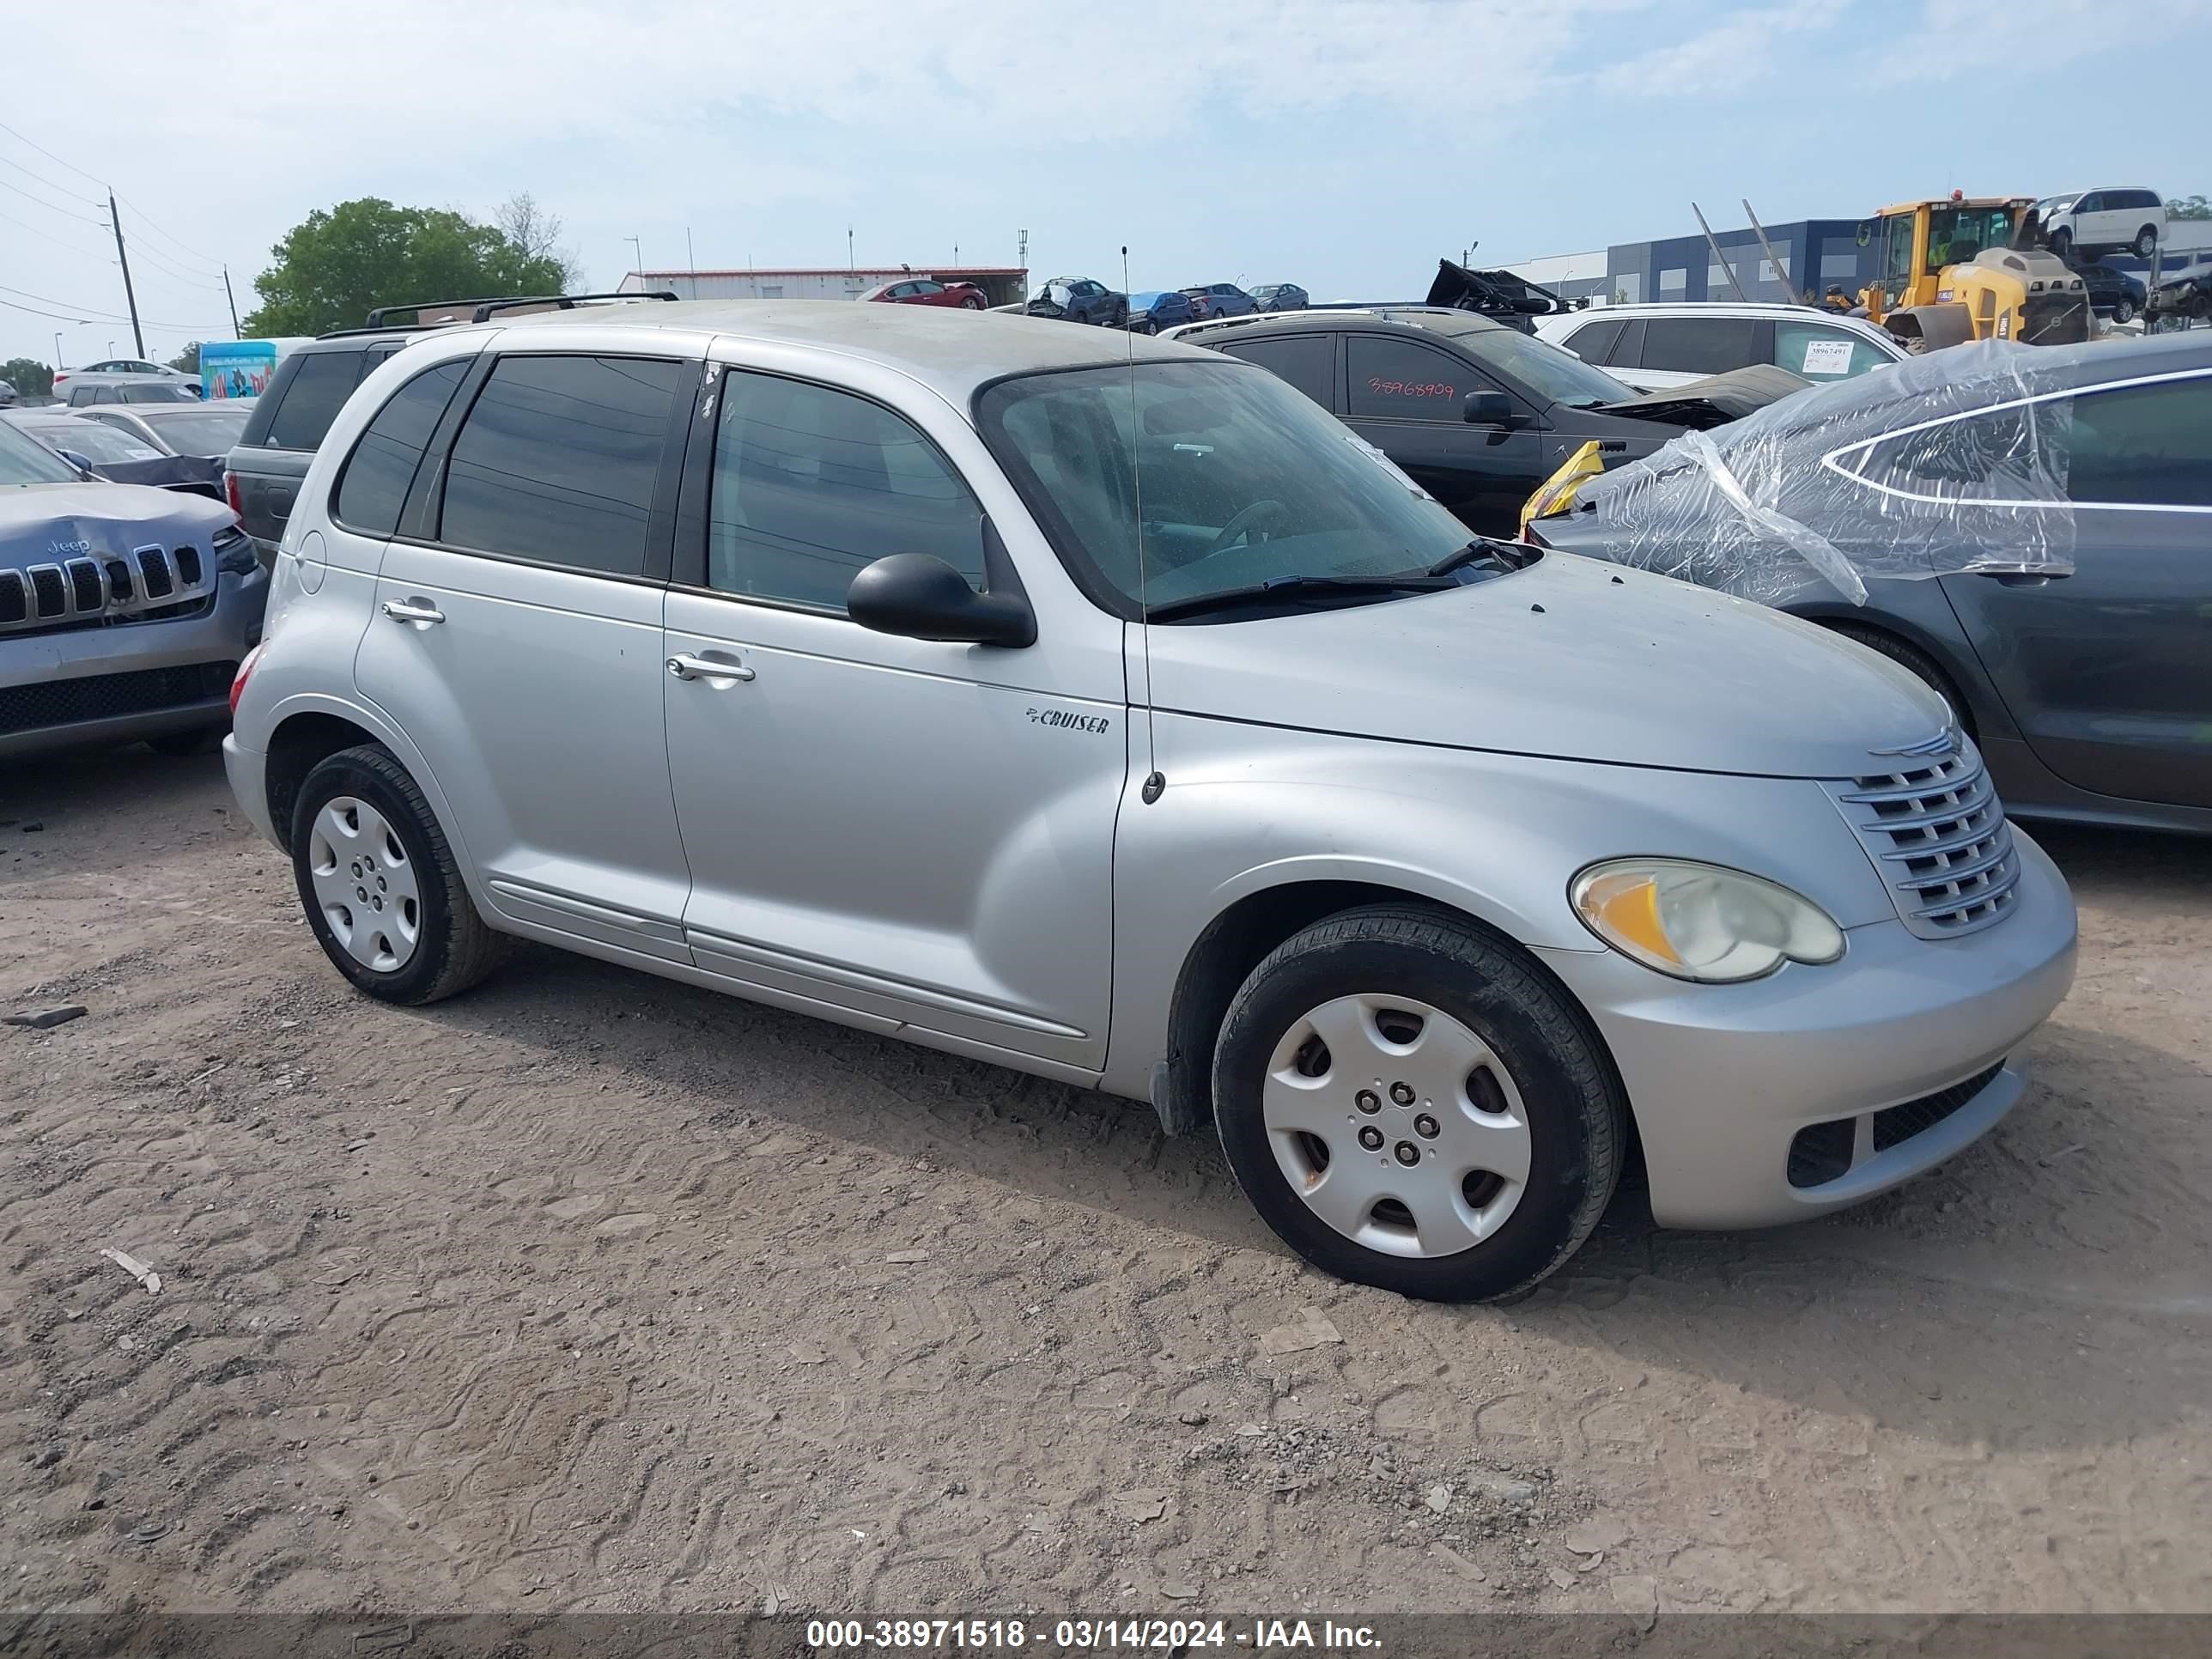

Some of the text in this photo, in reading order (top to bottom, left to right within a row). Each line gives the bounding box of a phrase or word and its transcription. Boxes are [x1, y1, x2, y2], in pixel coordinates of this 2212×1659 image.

[1367, 377, 1455, 403] 38968909
[47, 540, 91, 554] Jeep
[1040, 708, 1109, 734] CRUISER
